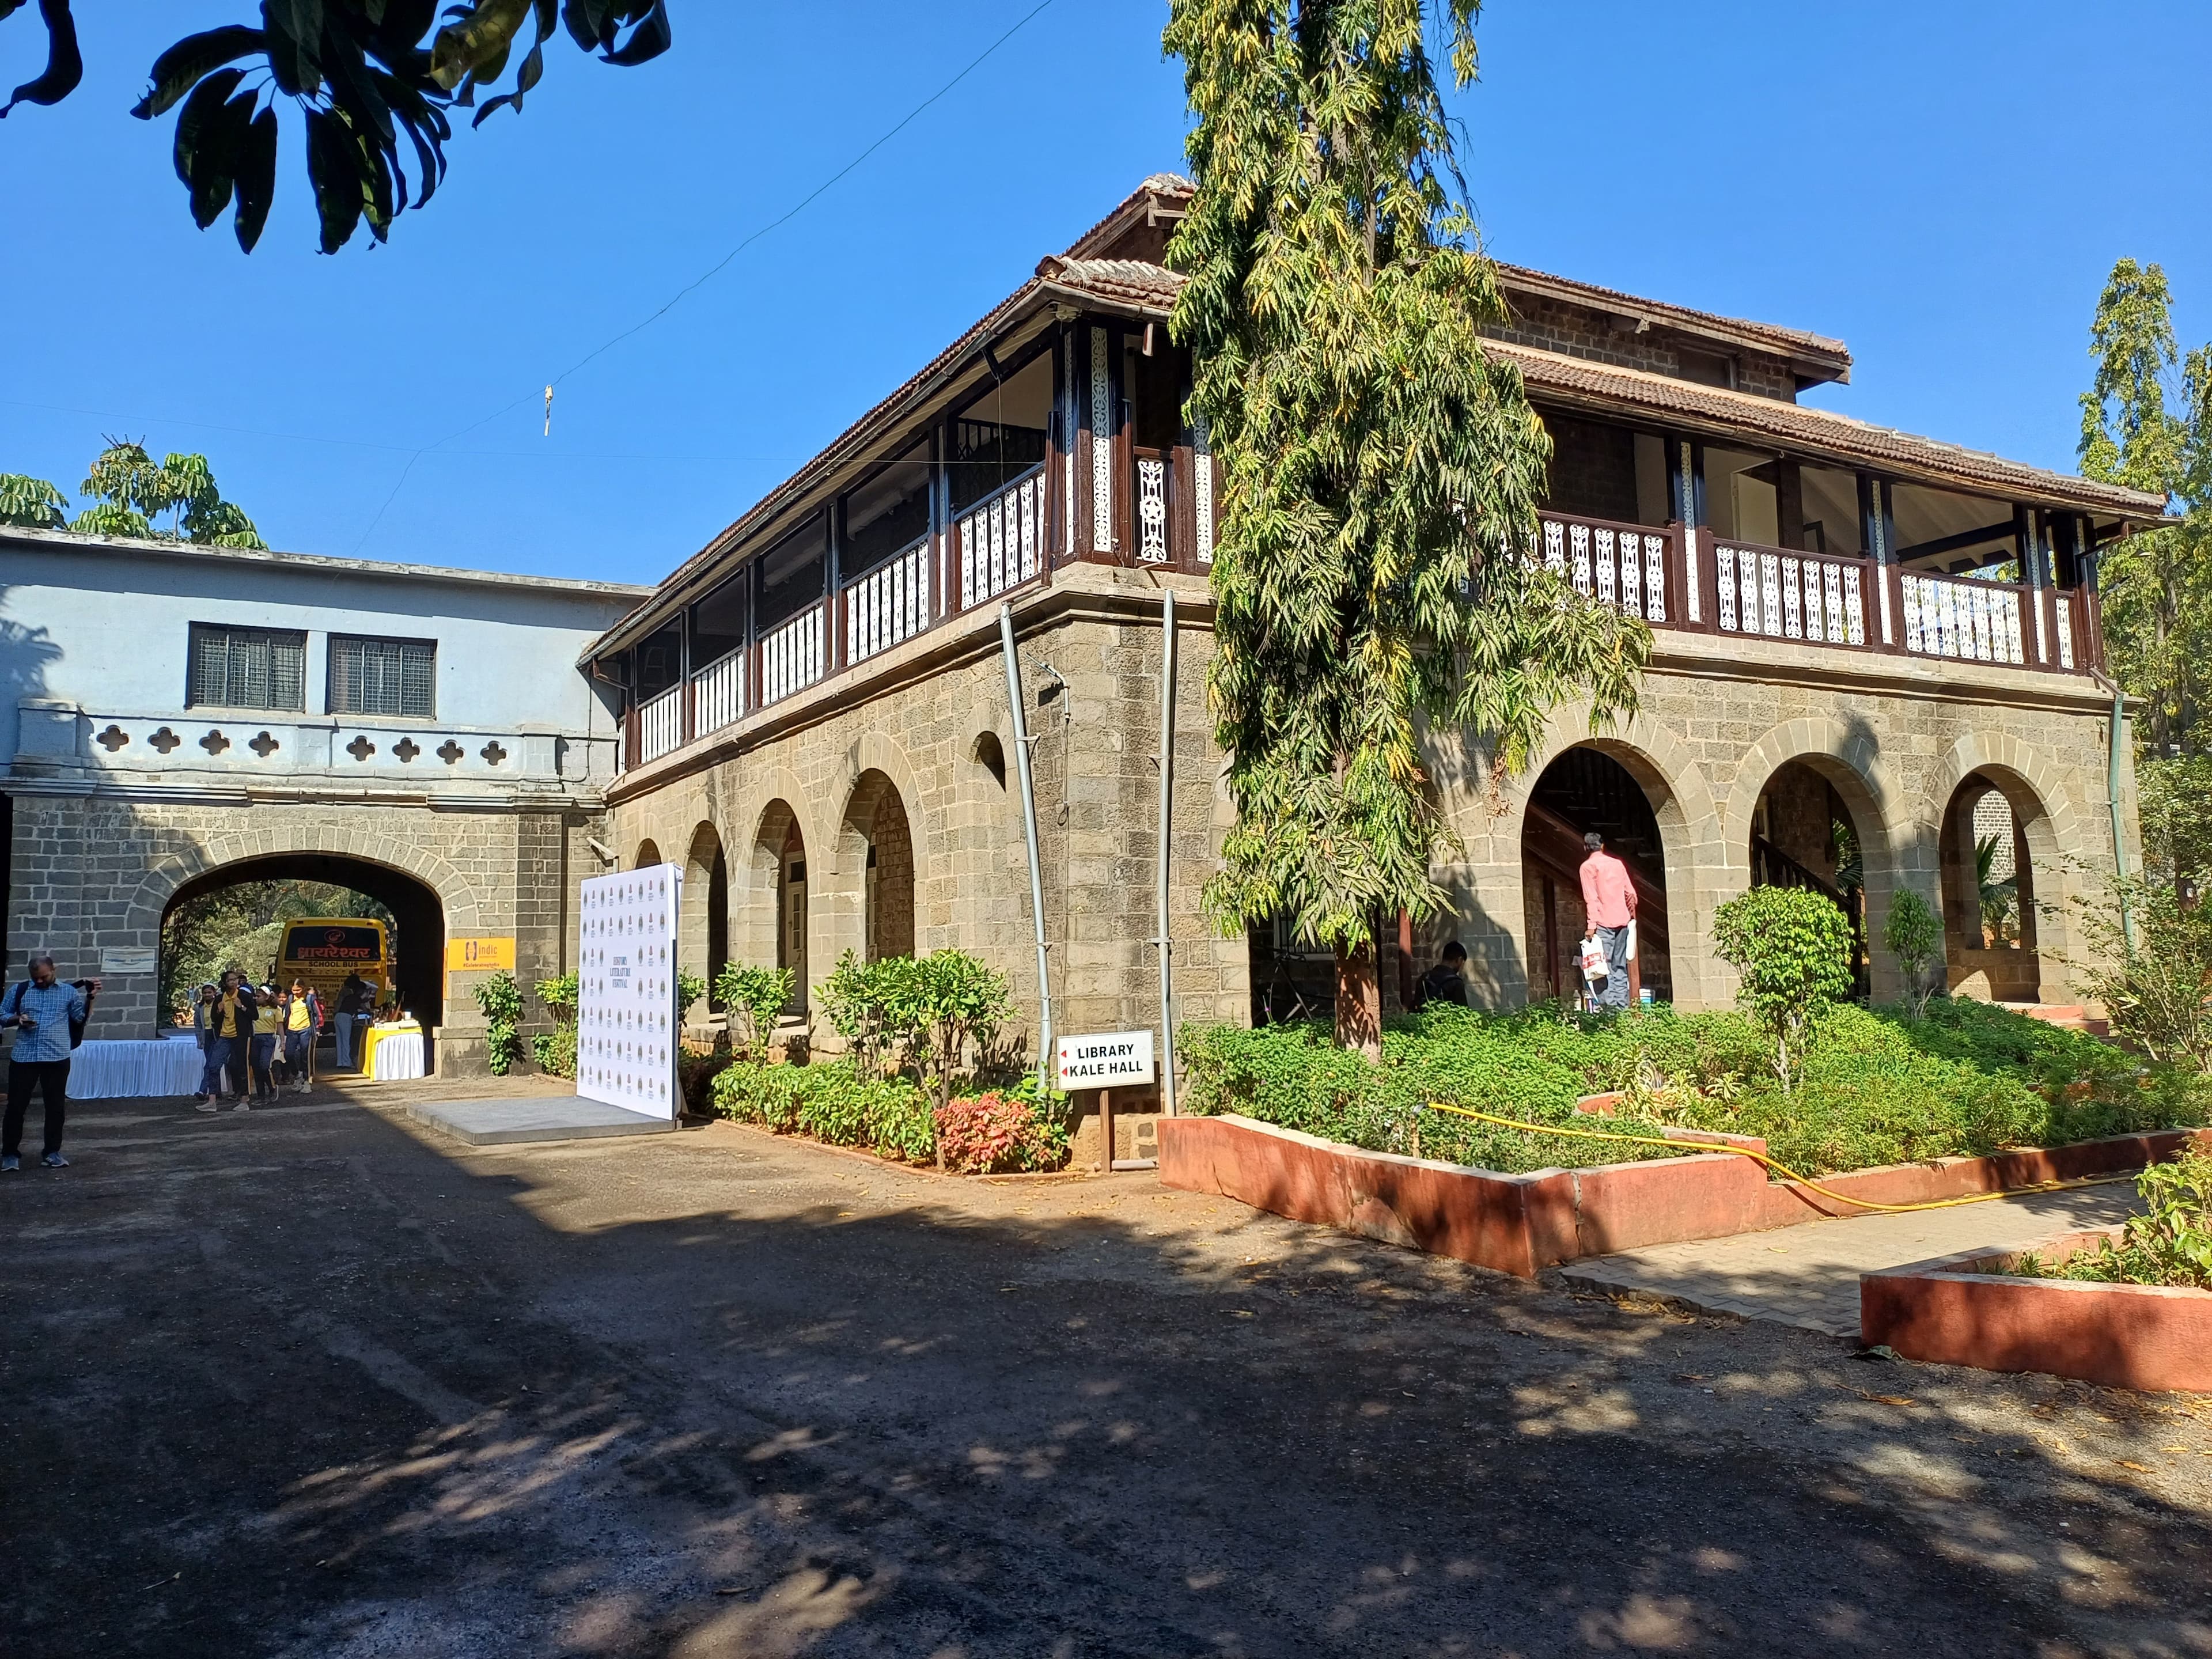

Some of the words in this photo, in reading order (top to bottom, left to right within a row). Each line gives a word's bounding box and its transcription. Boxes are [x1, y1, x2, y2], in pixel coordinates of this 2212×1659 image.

[479, 944, 498, 955] indic
[609, 968, 631, 976] LITERATURE
[612, 979, 627, 988] FESTIVAL
[1078, 1044, 1134, 1059] LIBRARY
[1070, 1063, 1104, 1077] KALE
[1109, 1060, 1143, 1074] HALL
